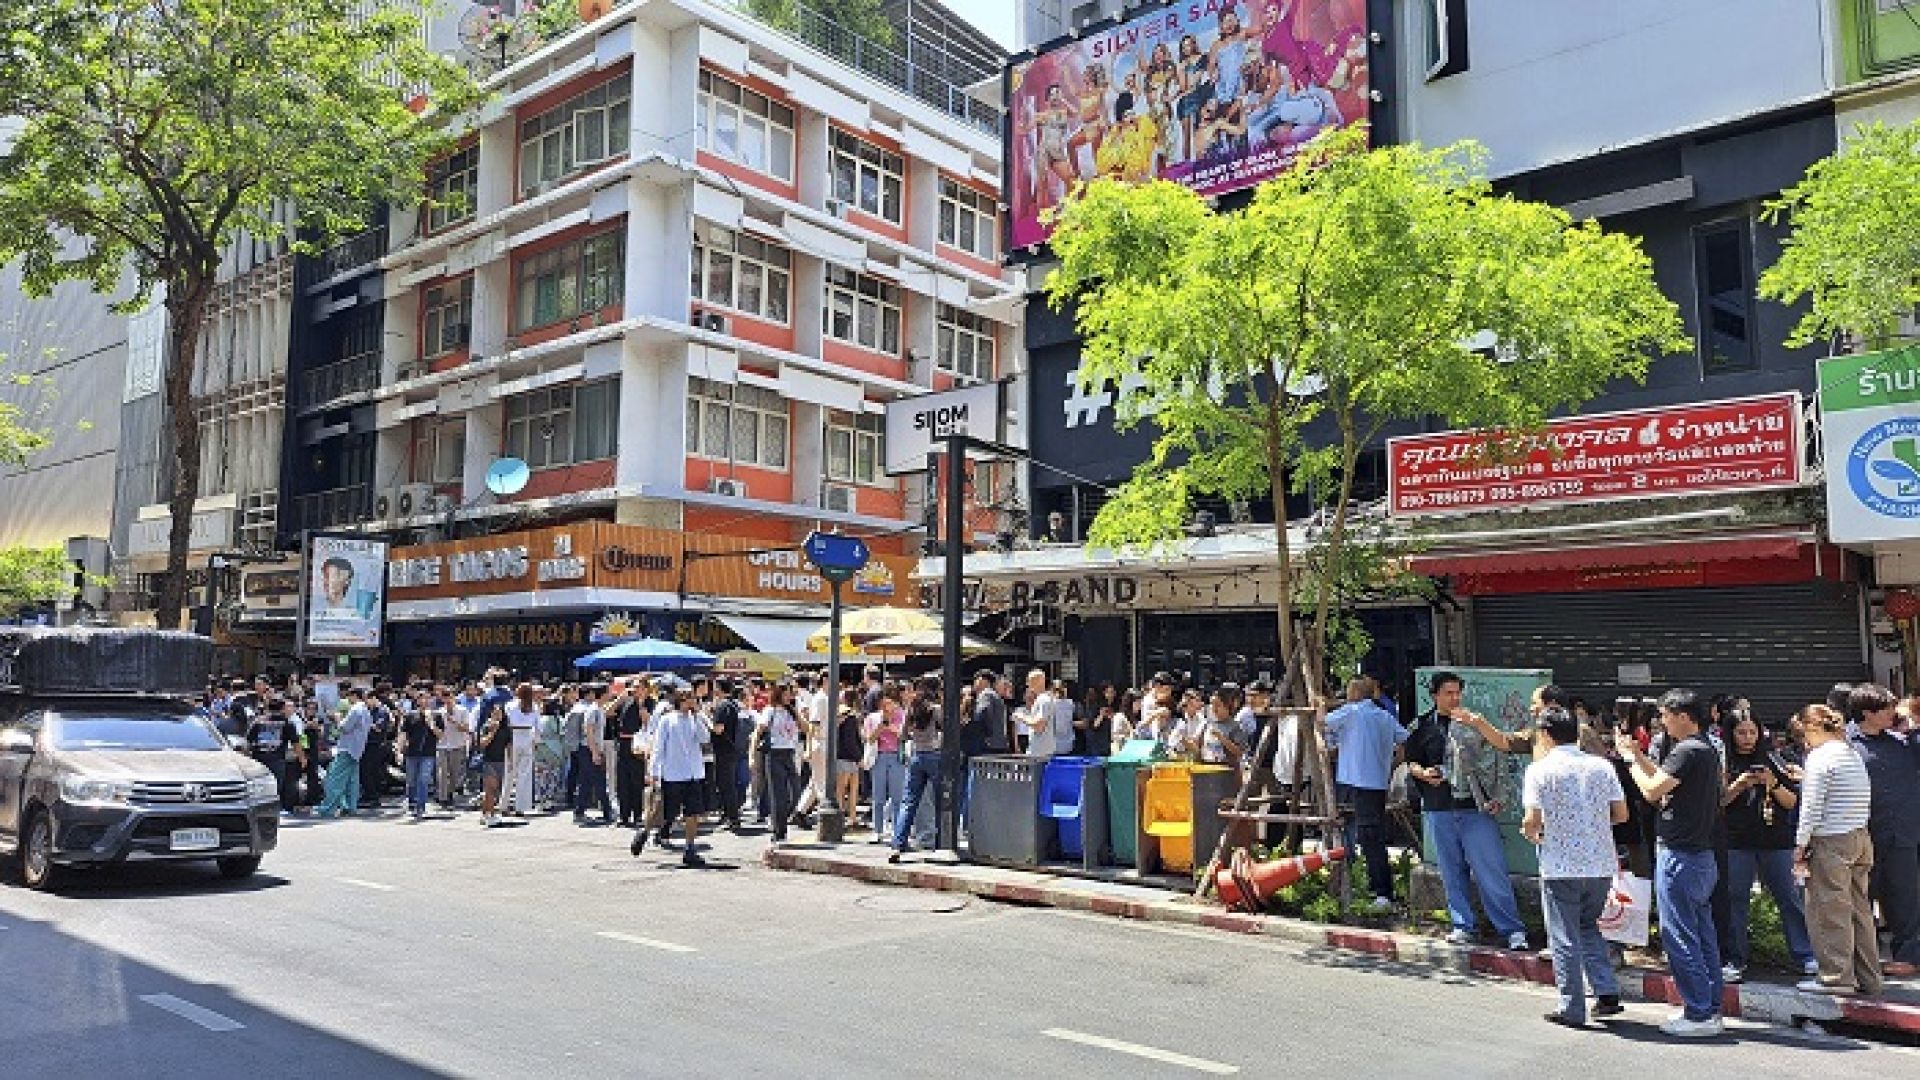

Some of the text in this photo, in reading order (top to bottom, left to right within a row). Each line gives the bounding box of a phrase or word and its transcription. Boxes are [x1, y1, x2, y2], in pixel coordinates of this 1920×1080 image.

[447, 545, 528, 581] TACOS
[602, 545, 673, 572] Corona
[749, 549, 798, 568] OPEN
[759, 570, 821, 593] HOURS
[455, 627, 514, 647] SUNRISE
[519, 624, 566, 645] TACOS
